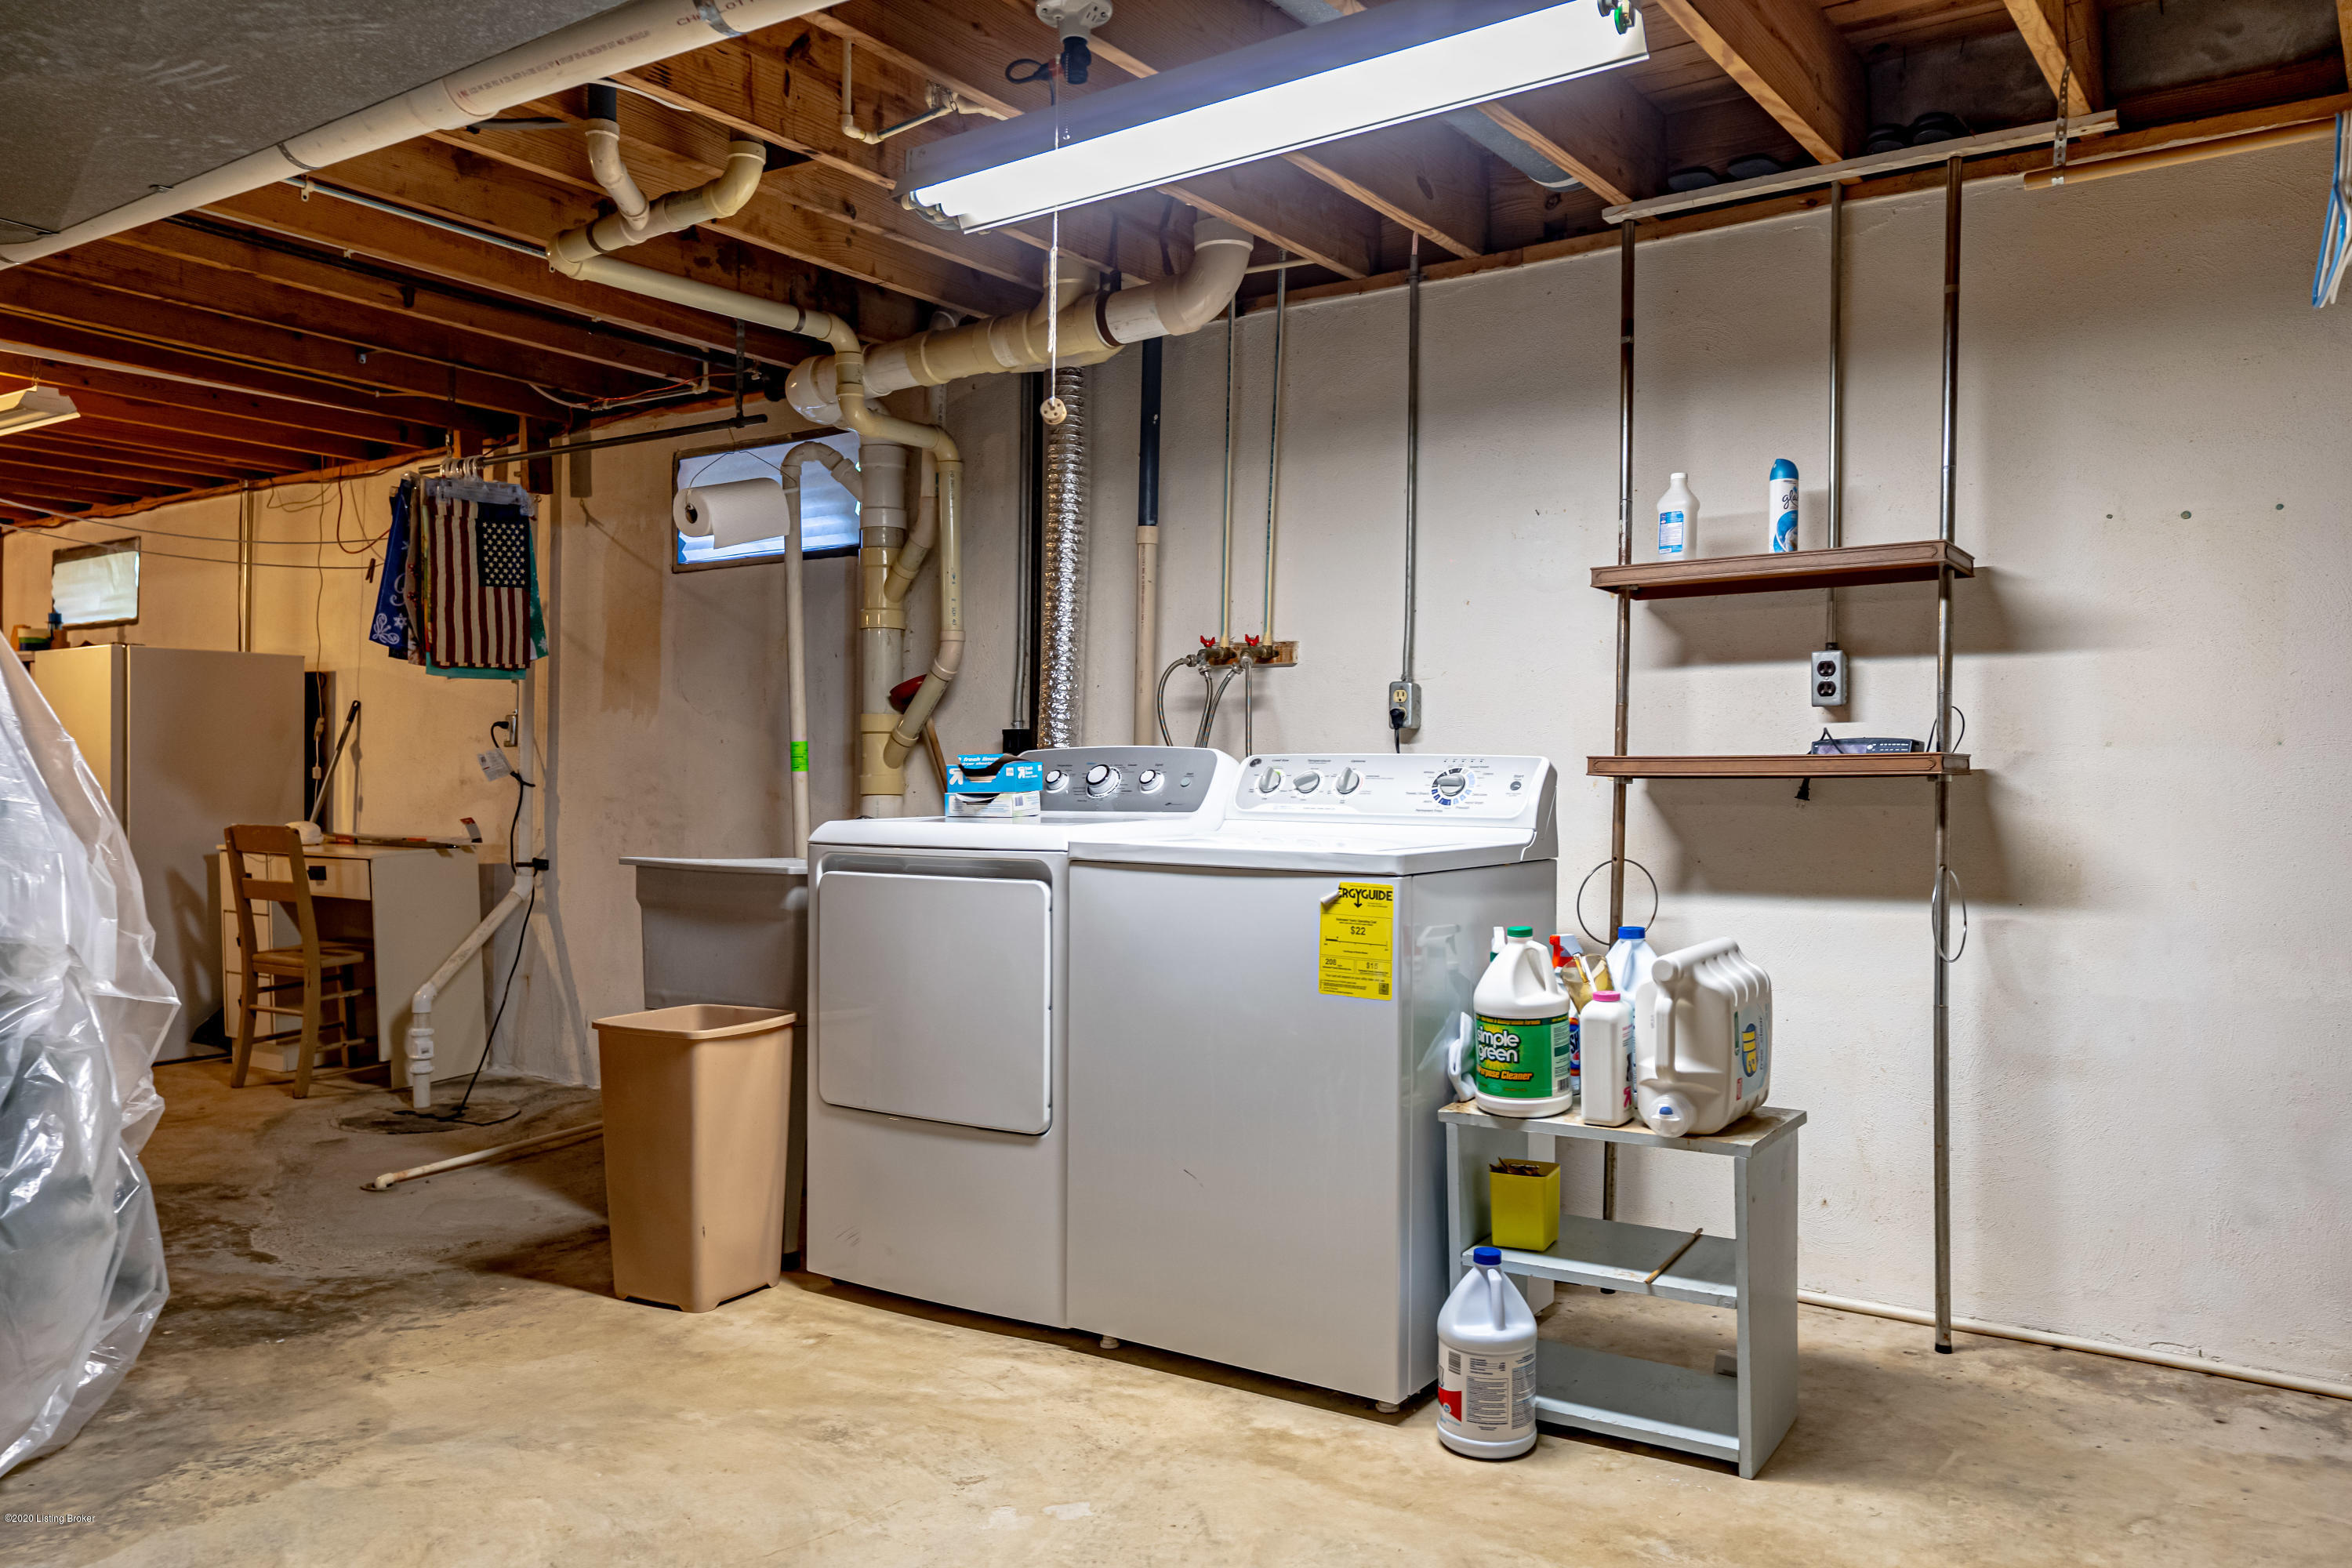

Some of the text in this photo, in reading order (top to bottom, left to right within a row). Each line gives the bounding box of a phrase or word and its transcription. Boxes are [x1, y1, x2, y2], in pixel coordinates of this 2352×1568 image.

[1338, 887, 1393, 902] ERGYGUIDE
[1350, 926, 1367, 935] $22
[1477, 1025, 1520, 1048] simple
[1478, 1044, 1519, 1063] green
[1501, 1070, 1533, 1080] Cleaner
